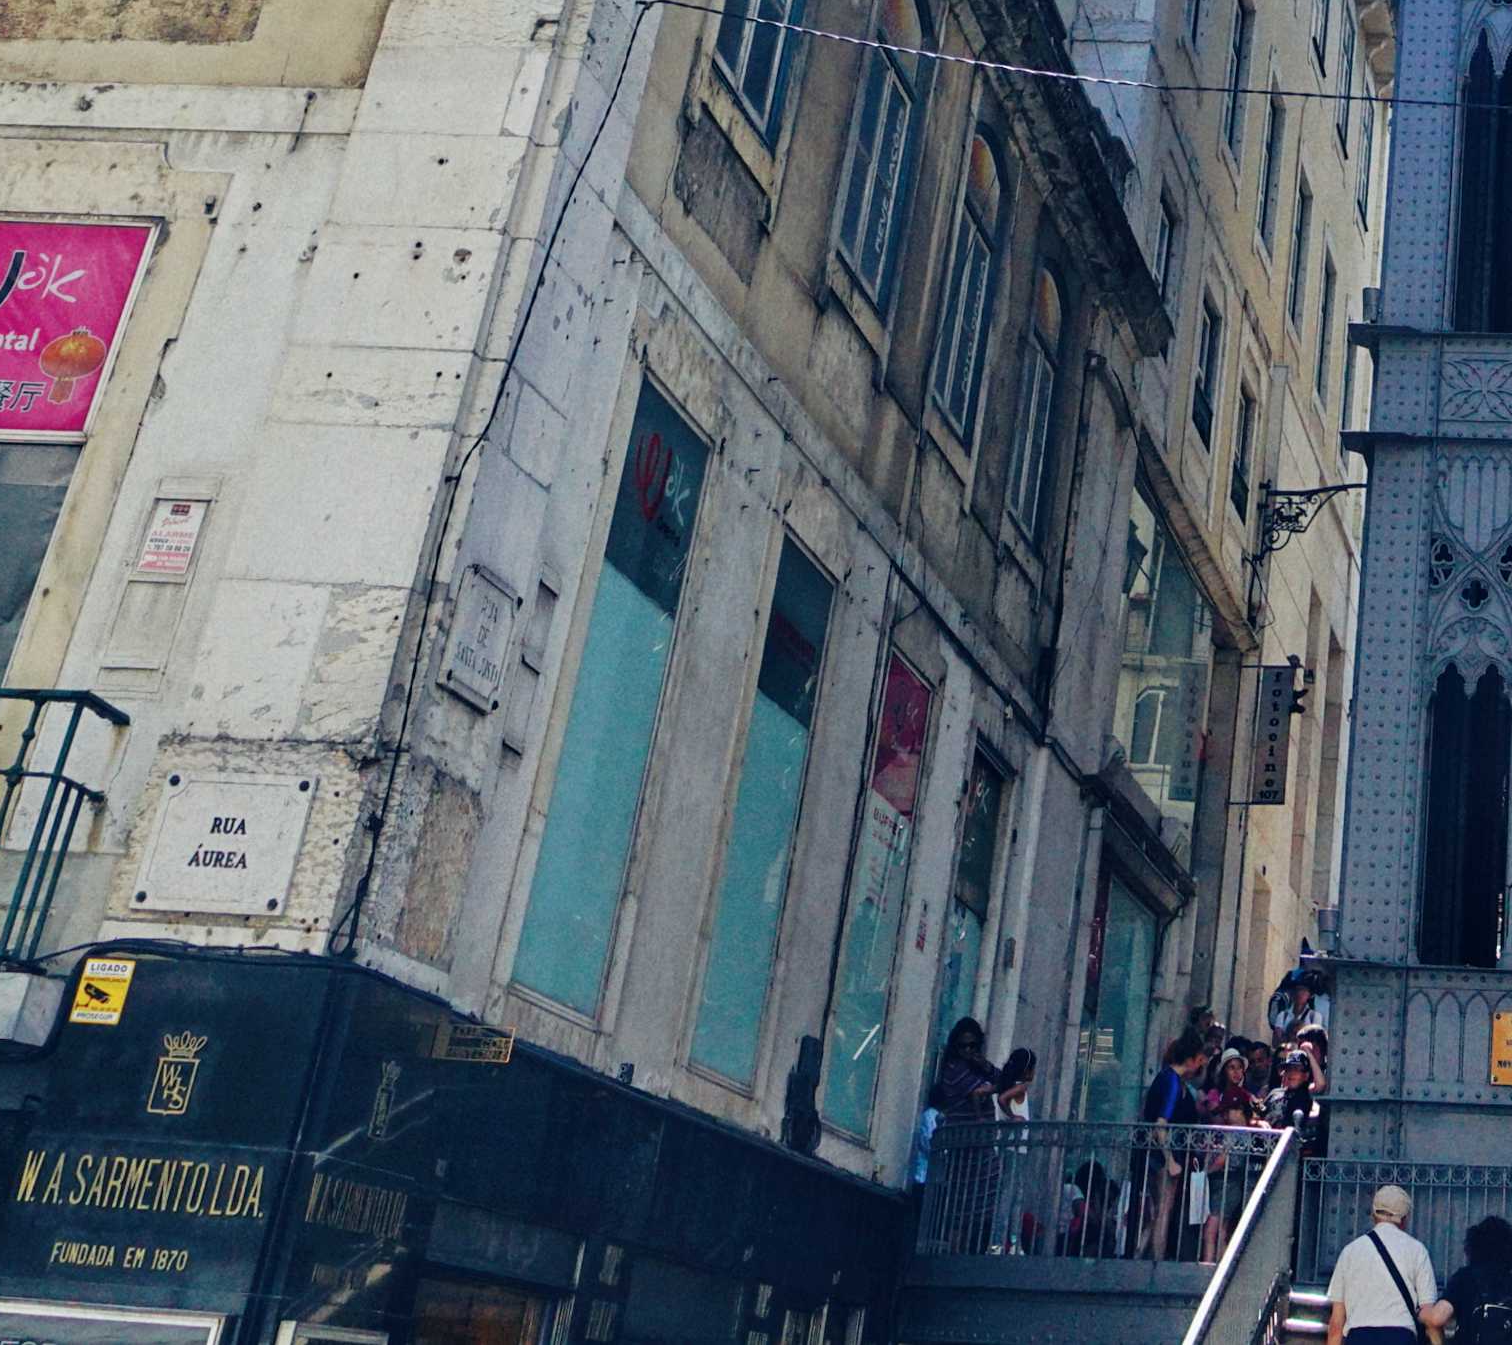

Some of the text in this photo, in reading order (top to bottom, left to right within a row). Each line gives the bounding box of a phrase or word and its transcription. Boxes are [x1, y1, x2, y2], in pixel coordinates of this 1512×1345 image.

[209, 816, 247, 835] RUA
[187, 842, 248, 869] ÁUREA
[91, 964, 128, 973] LIGADO
[17, 1150, 46, 1202] W.
[42, 1152, 66, 1205] A.
[50, 1241, 189, 1272] FUNDADA EM 1870
